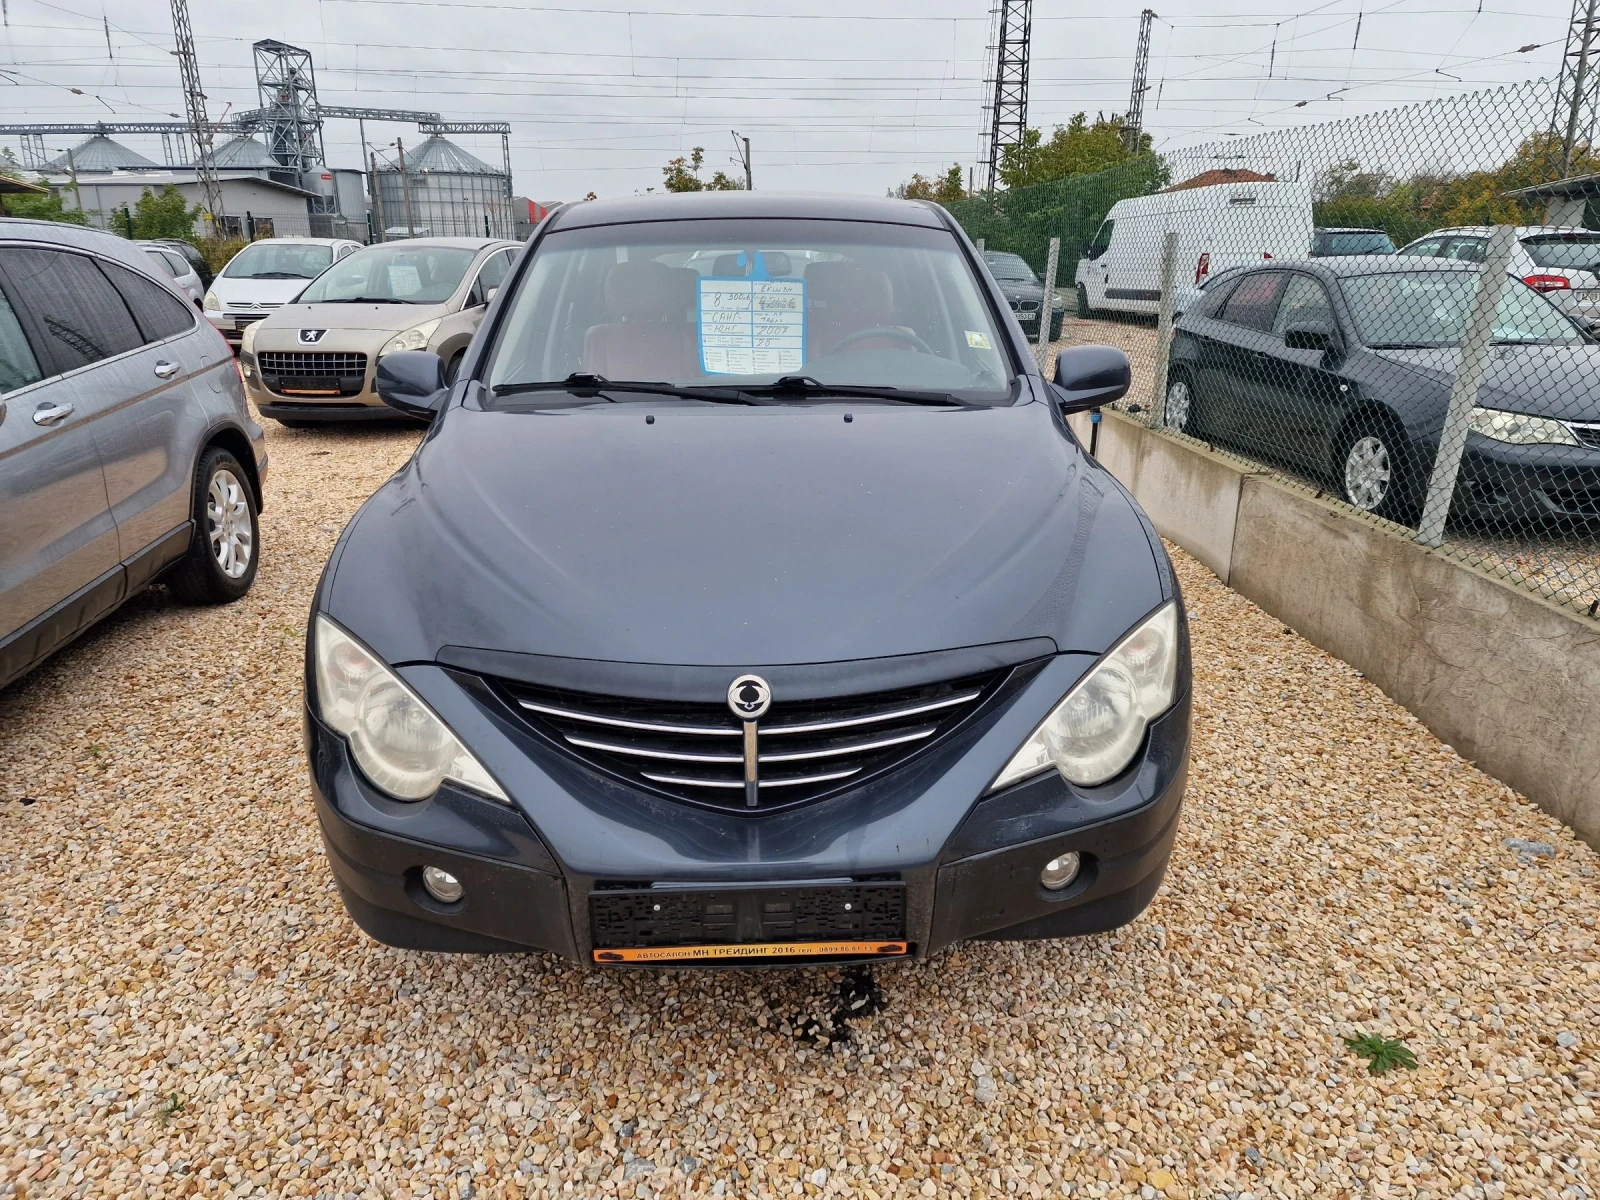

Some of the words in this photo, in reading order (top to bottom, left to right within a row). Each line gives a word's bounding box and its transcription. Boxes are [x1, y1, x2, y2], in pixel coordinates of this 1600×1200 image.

[713, 291, 722, 307] 8
[636, 951, 691, 959] АВТОСАЛОН
[713, 947, 770, 956] ТРЕЙДИНГ
[771, 946, 796, 954] 2016
